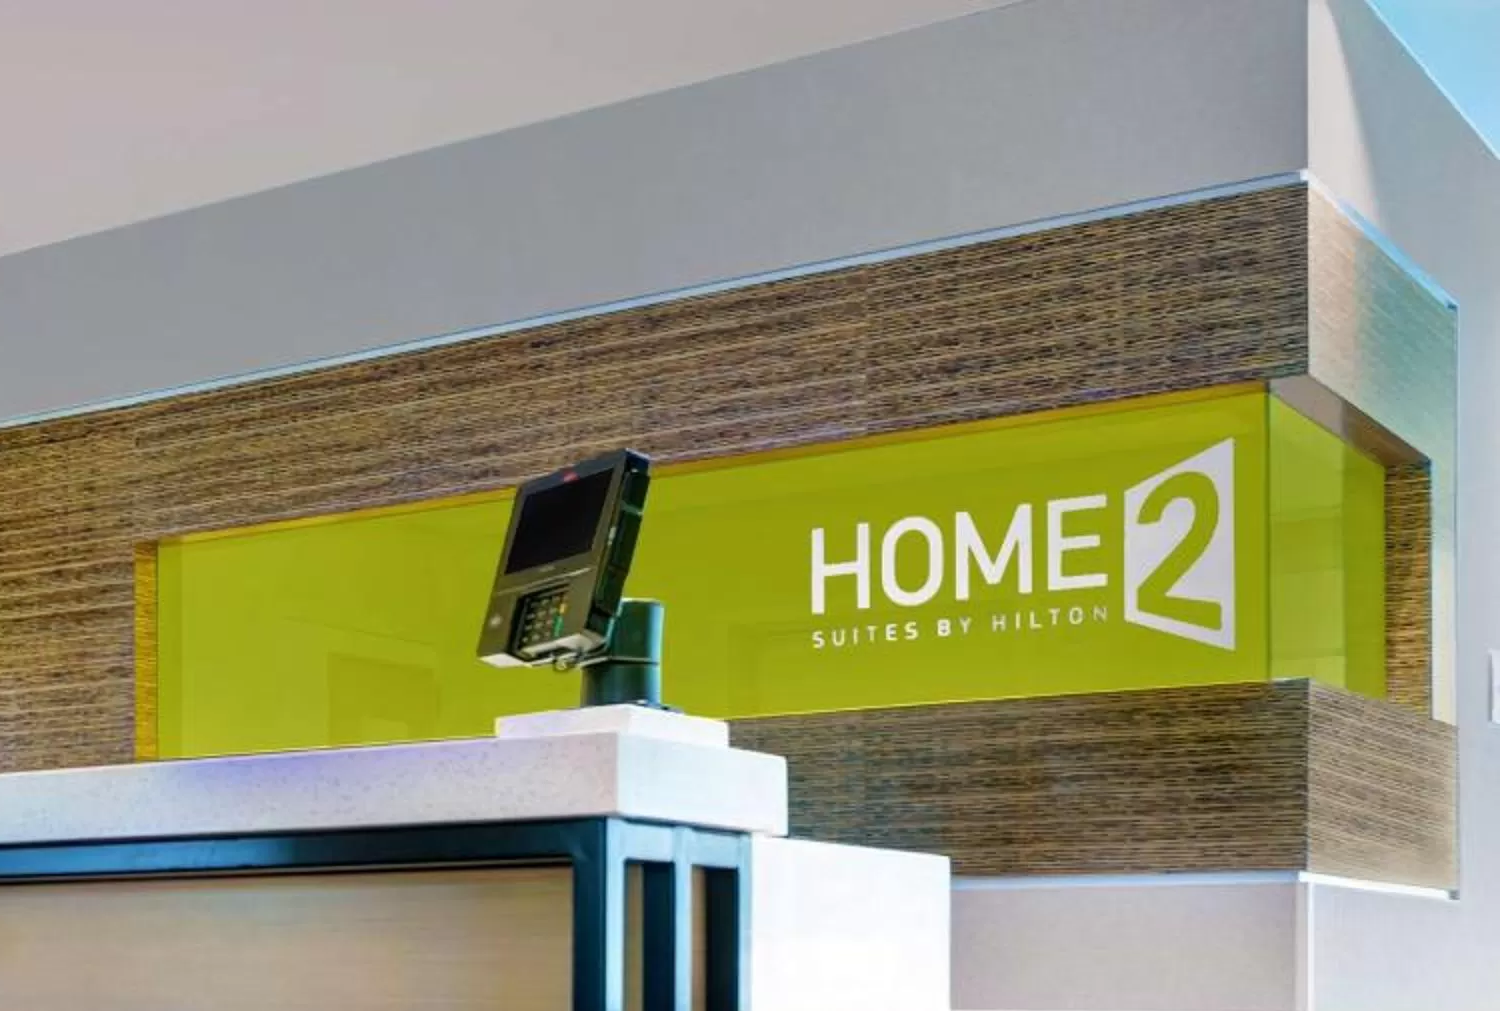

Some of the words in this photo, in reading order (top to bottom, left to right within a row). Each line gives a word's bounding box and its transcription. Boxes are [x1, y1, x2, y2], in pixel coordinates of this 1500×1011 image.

[811, 621, 920, 650] SUITES
[936, 616, 972, 638] BY
[991, 606, 1108, 632] HILTON
